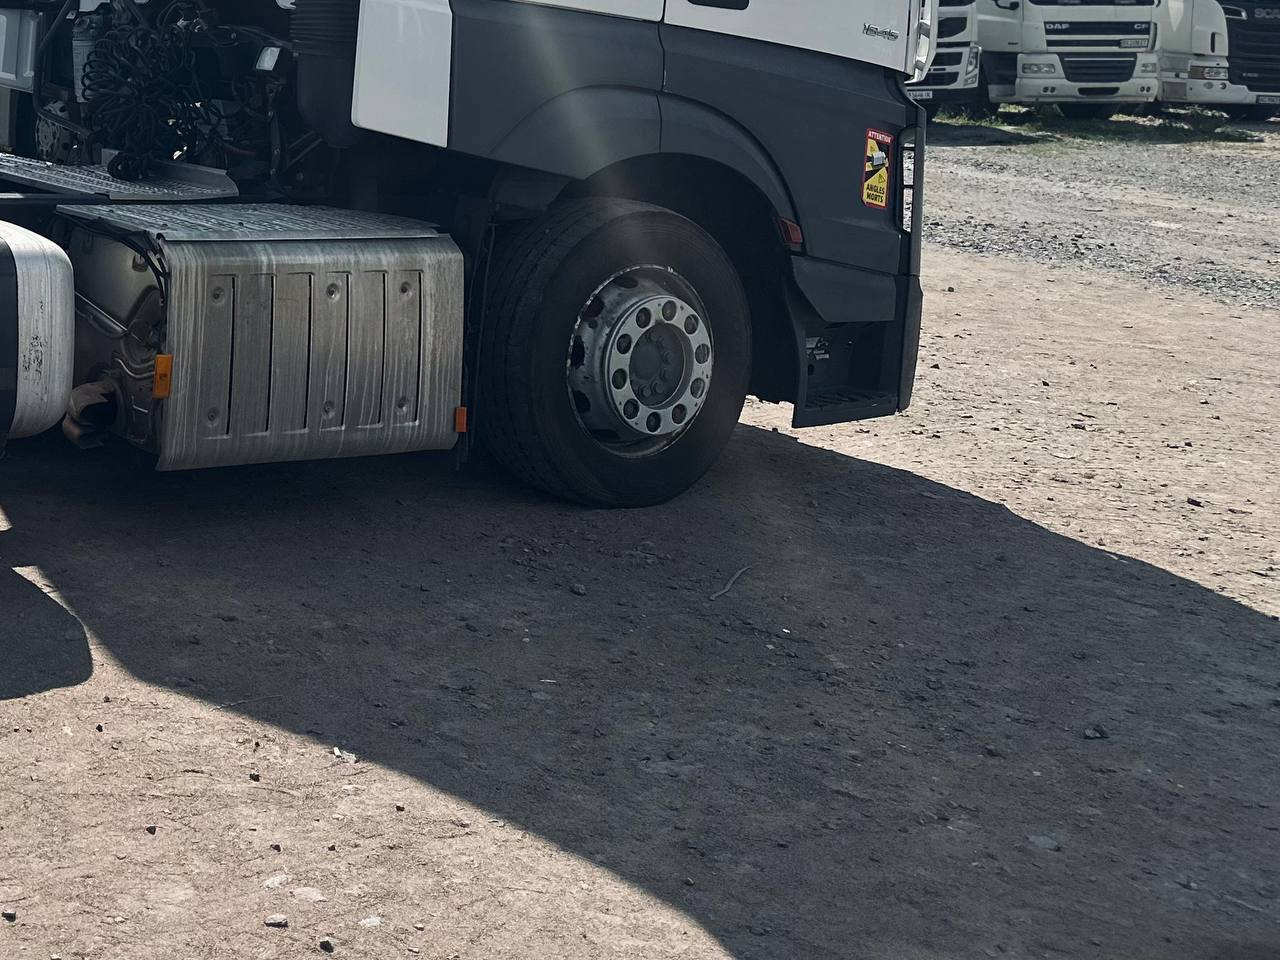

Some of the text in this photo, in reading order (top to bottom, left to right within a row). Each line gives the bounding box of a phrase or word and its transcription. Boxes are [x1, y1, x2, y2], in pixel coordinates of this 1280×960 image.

[868, 130, 892, 143] ATTENTION
[866, 183, 885, 195] ANGLES
[866, 192, 884, 203] MORTS
